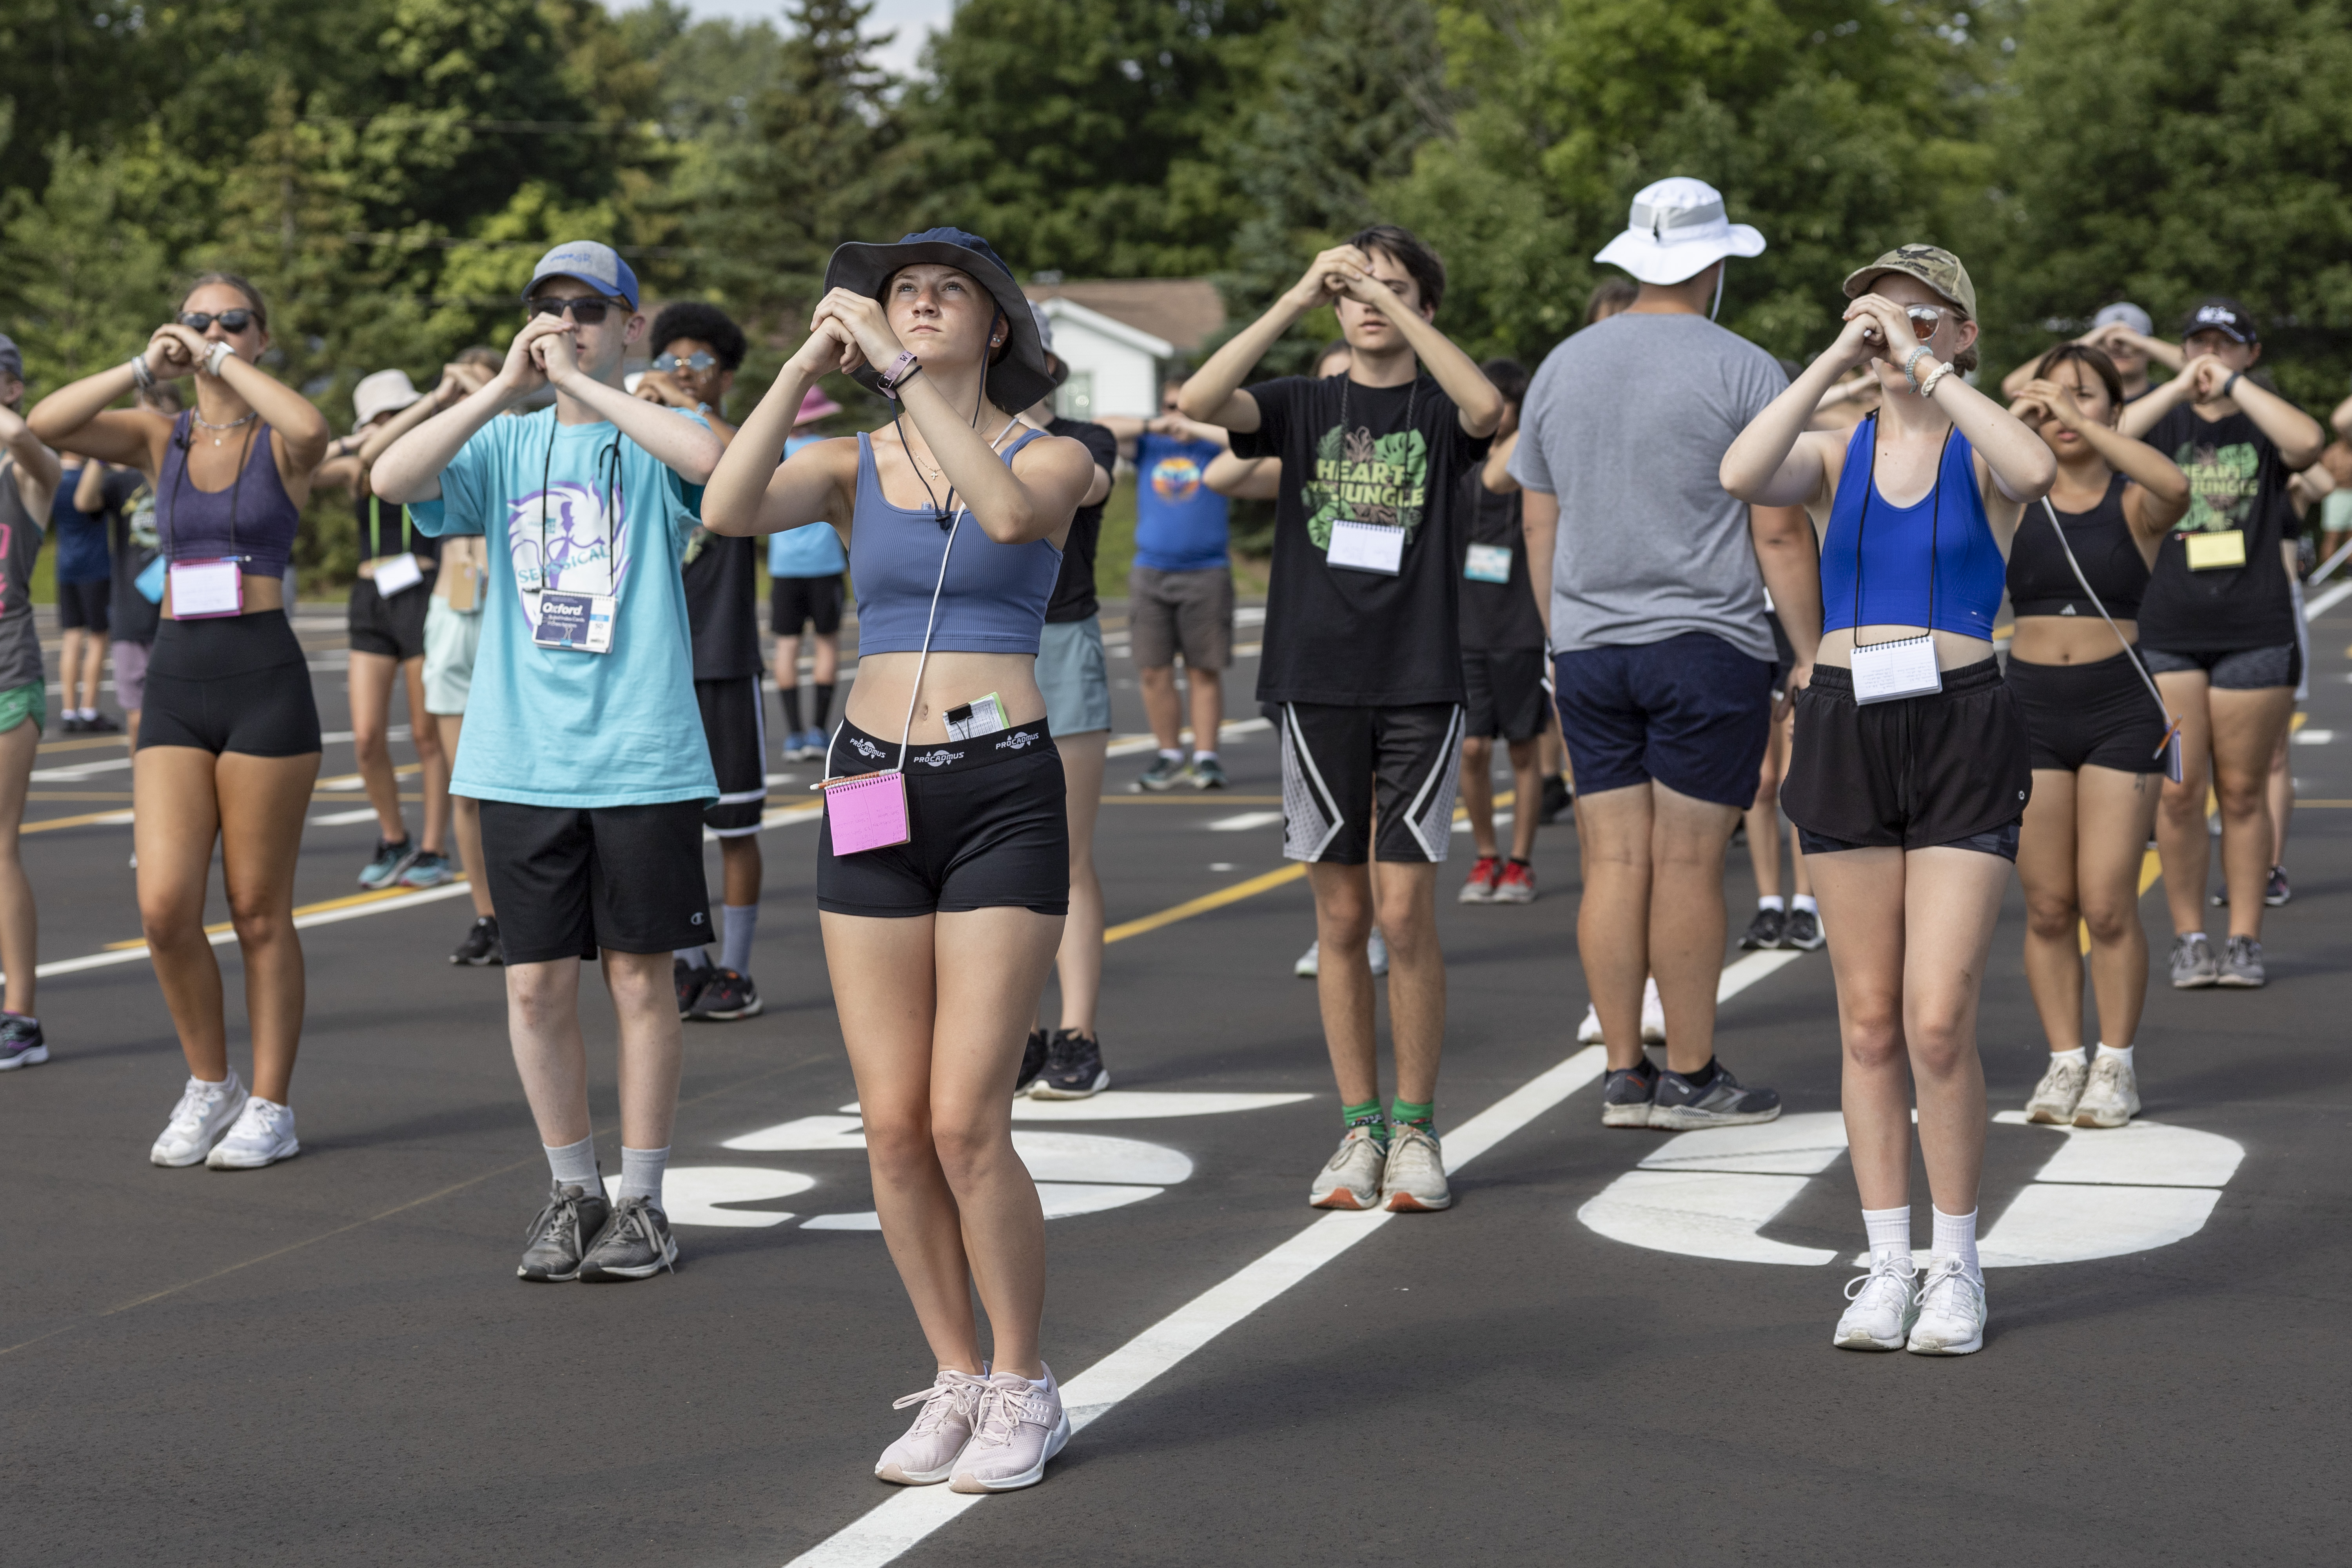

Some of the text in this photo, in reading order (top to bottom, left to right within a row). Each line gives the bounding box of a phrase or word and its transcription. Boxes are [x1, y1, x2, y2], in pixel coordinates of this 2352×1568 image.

[1316, 458, 1405, 486] HEART
[1331, 483, 1425, 508] JUNGLE
[518, 545, 610, 583] SEUSSICAL
[542, 602, 583, 616] Oxford
[850, 738, 886, 758] PROCADMUS
[996, 733, 1039, 750] PROCADMUS
[913, 752, 964, 763] PROCADMUS
